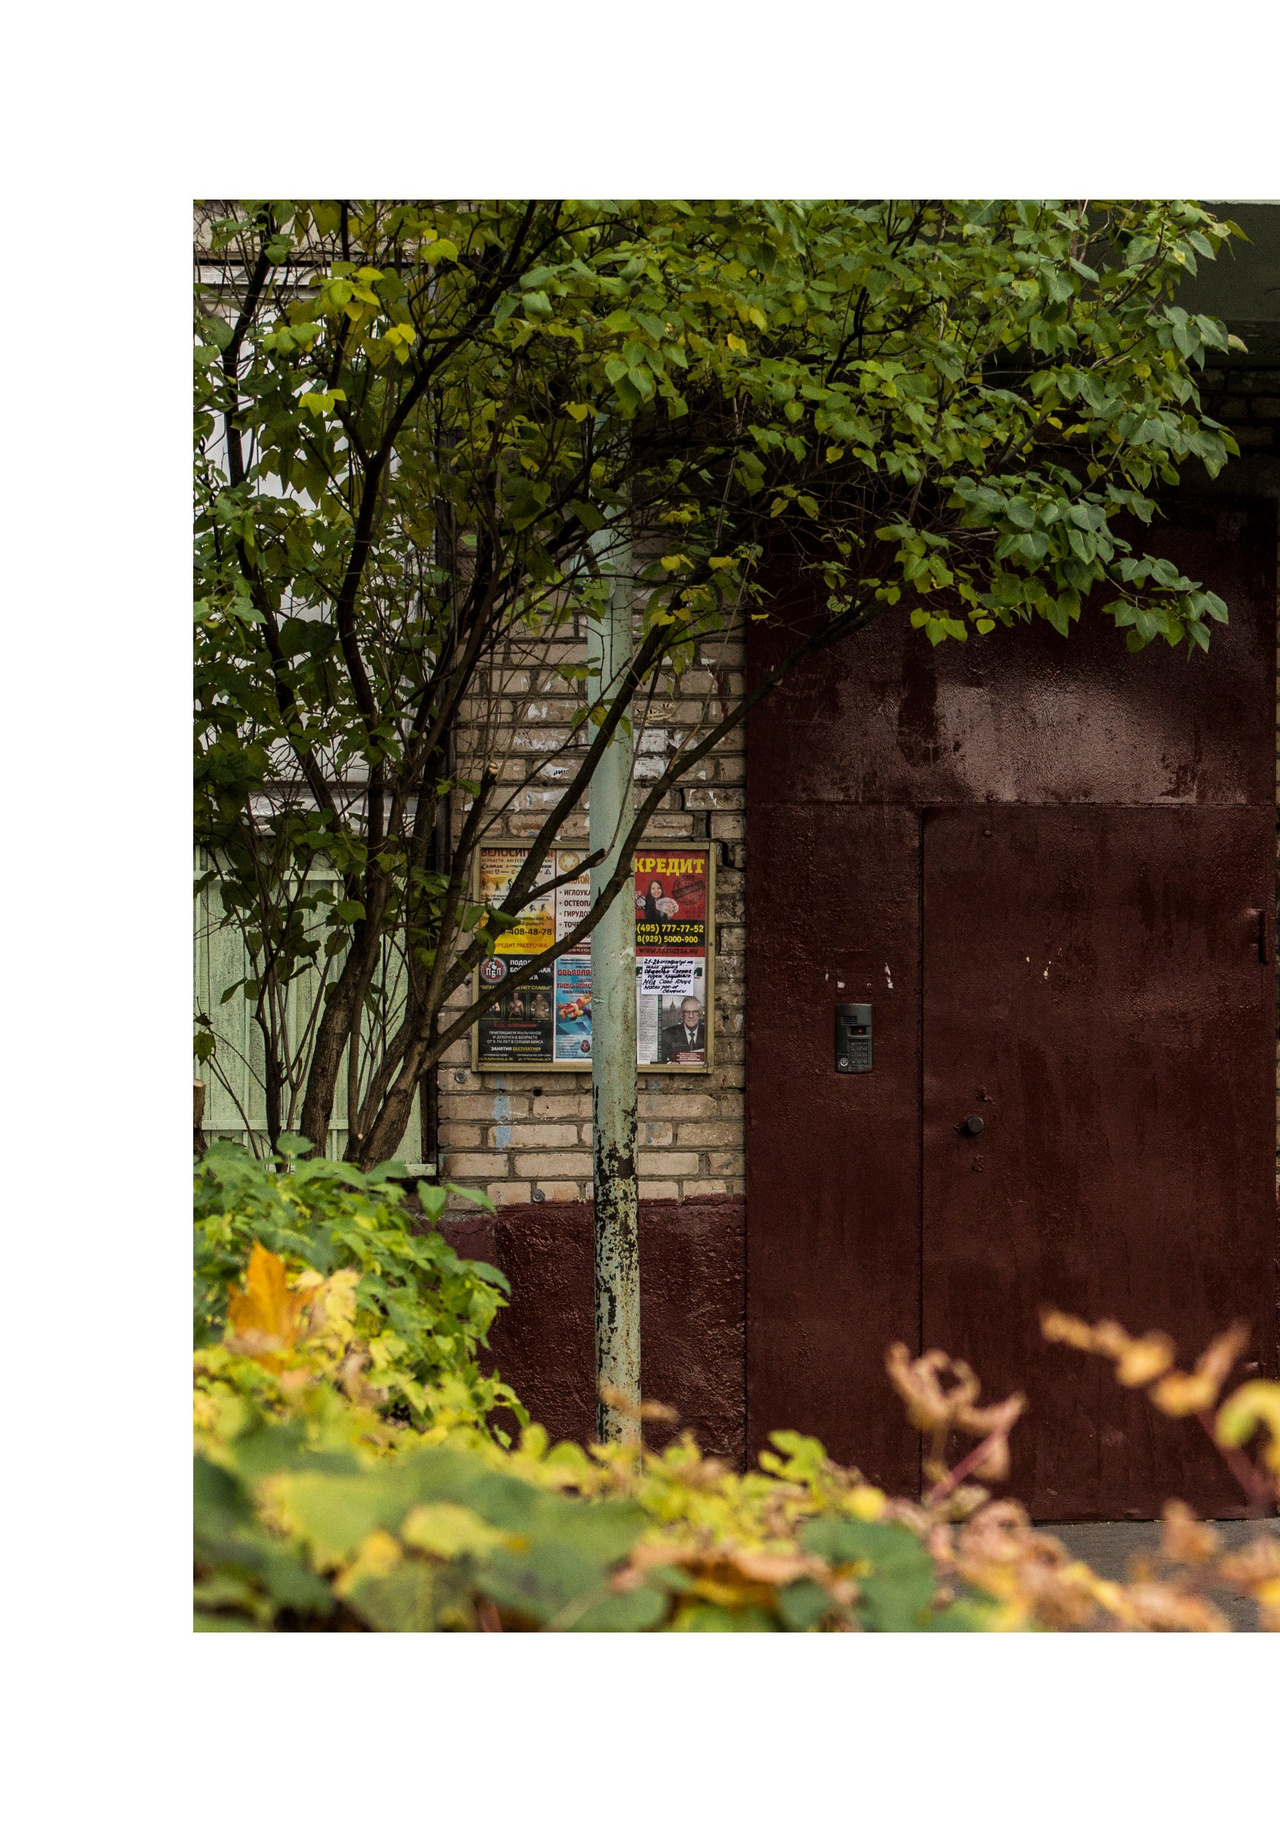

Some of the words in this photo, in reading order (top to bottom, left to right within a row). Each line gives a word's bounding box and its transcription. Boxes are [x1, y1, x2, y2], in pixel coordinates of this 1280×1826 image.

[635, 857, 705, 876] КРЕДИТ
[502, 928, 552, 936] -408-48-78
[636, 923, 660, 934] (495)
[661, 924, 704, 933] 777-77-52
[637, 935, 662, 944] 8(929)
